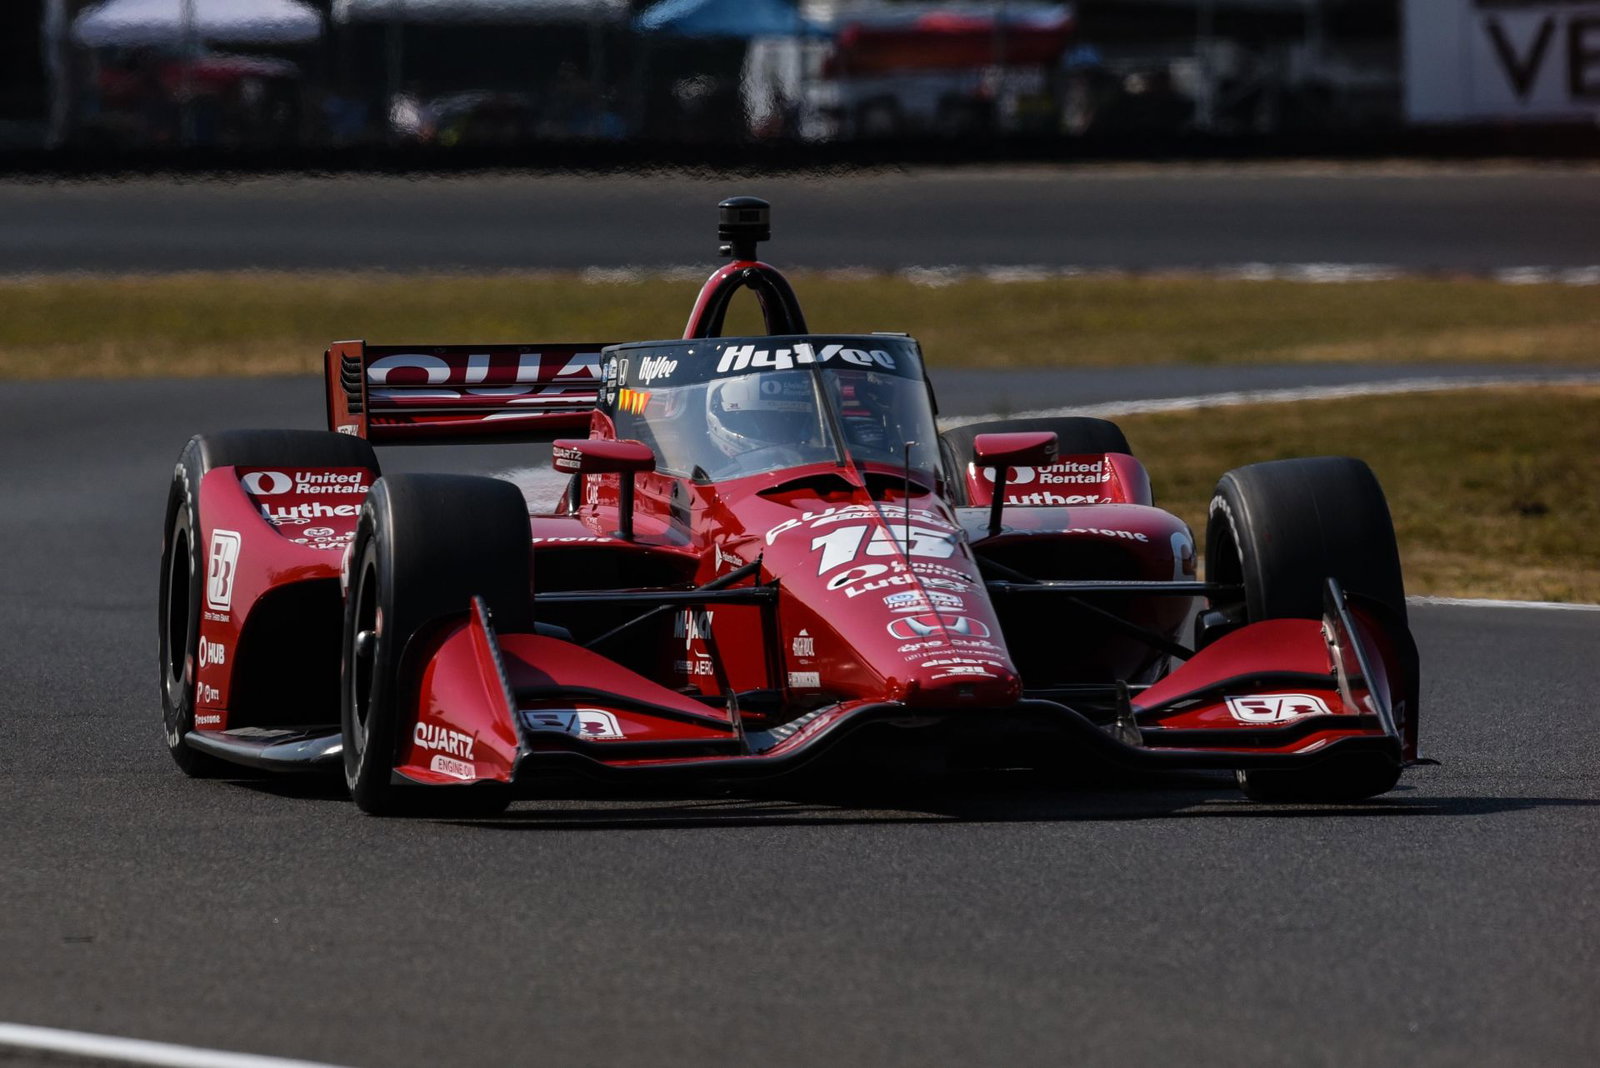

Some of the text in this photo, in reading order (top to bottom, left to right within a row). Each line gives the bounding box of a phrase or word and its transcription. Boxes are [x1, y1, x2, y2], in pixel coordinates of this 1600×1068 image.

[638, 356, 678, 385] HyVee
[716, 343, 897, 372] HyVee
[295, 472, 362, 483] United
[296, 483, 369, 494] Rentals
[811, 524, 956, 576] 15
[207, 642, 225, 664] HUB
[413, 721, 474, 760] QUARTZ
